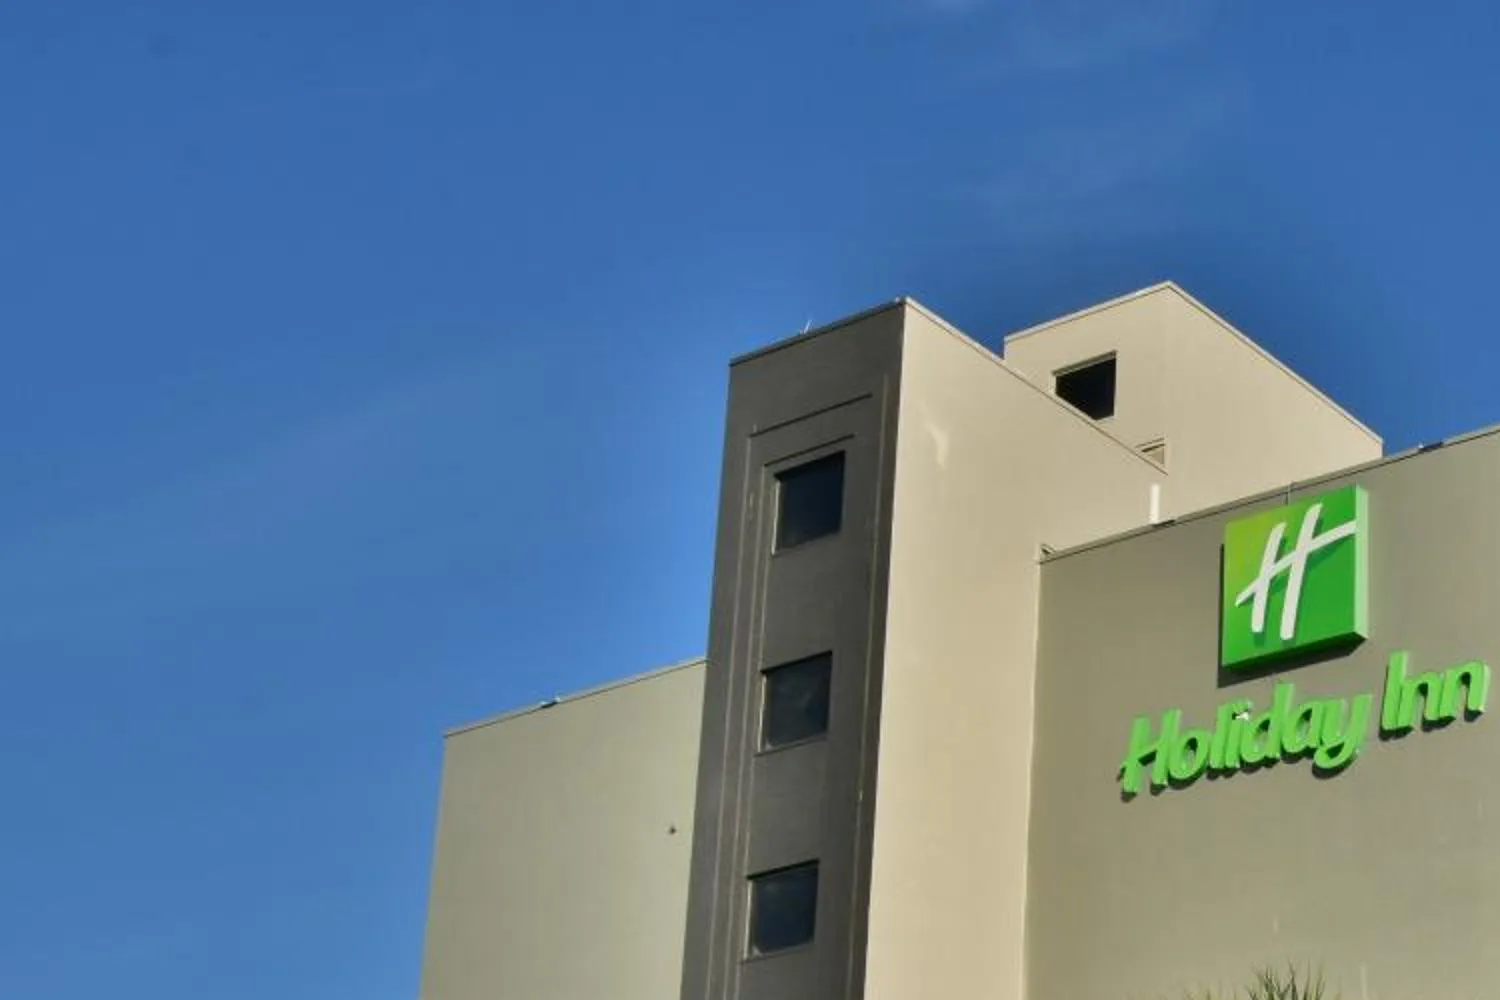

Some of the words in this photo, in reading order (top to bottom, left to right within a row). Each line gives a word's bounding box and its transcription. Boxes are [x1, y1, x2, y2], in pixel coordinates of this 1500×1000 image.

[1235, 502, 1358, 640] H
[1119, 683, 1373, 794] Holiday
[1381, 650, 1490, 731] Inn
